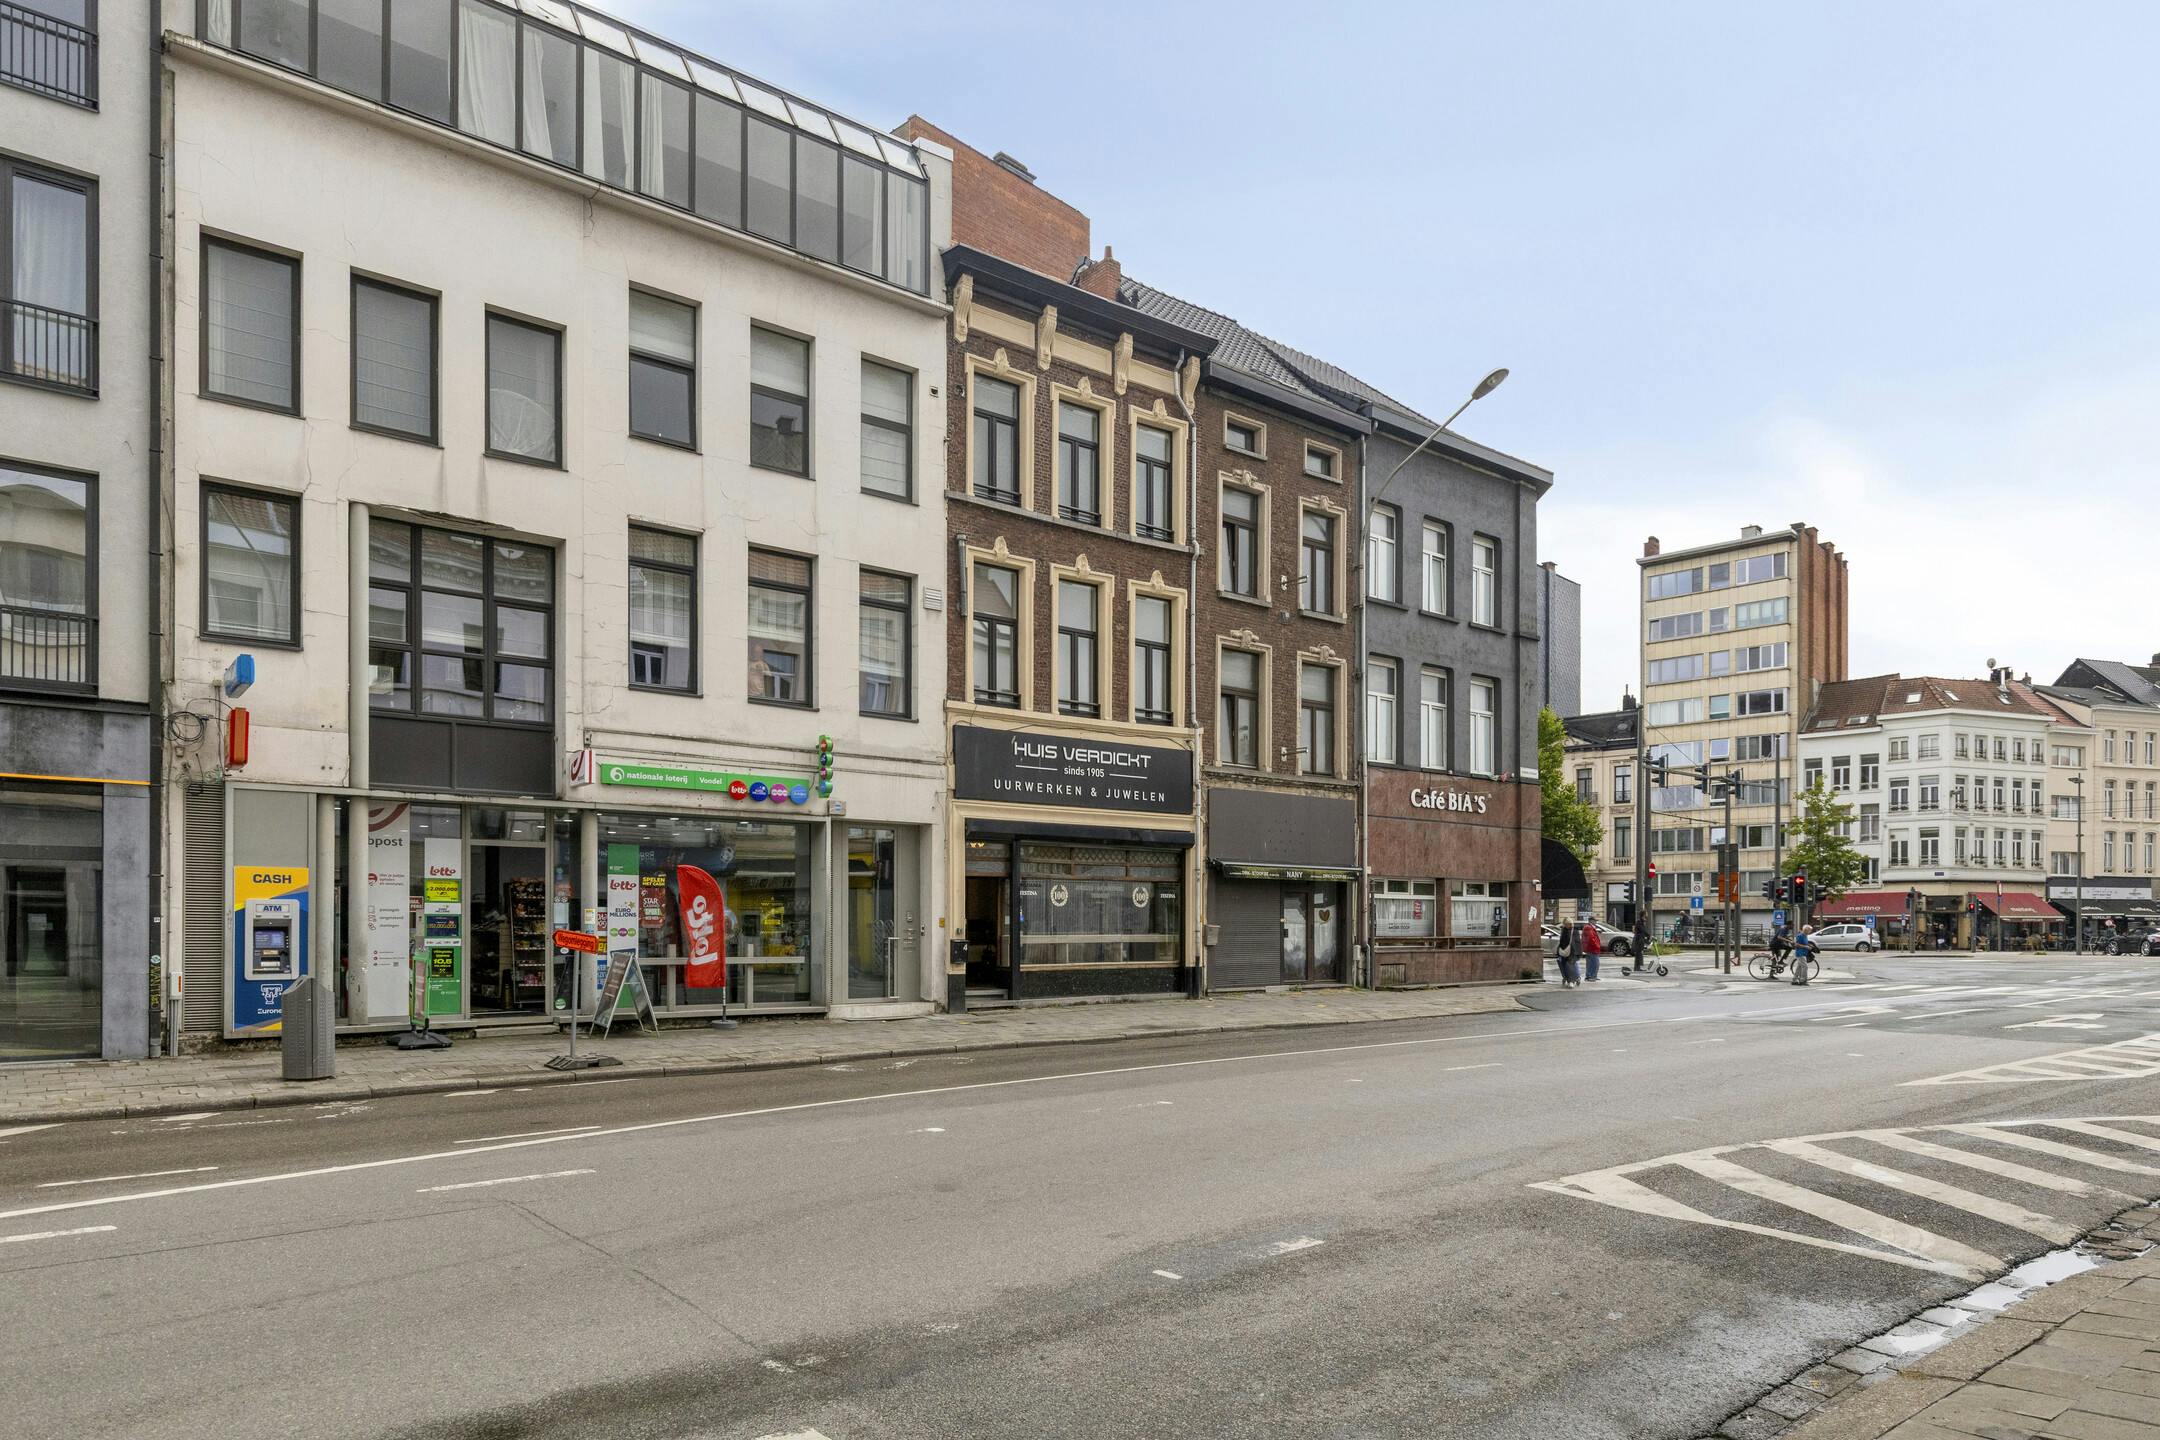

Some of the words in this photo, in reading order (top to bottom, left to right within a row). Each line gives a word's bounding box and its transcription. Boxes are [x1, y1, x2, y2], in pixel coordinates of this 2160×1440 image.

[1063, 747, 1151, 768] VERDICKT
[1063, 766, 1085, 776] sinds
[1087, 768, 1105, 778] 1905
[626, 772, 664, 781] nationale
[665, 774, 689, 785] loterij
[994, 779, 1082, 796] UURWERKEN
[1090, 787, 1097, 797] &
[1106, 788, 1165, 802] JUWELEN
[1410, 788, 1446, 810] Café
[430, 865, 456, 876] Lotto
[1286, 871, 1304, 879] NANY
[252, 873, 292, 884] CASH
[609, 879, 637, 891] Lotto
[557, 933, 595, 950] Wegomlegging
[257, 1007, 283, 1015] Eurone
